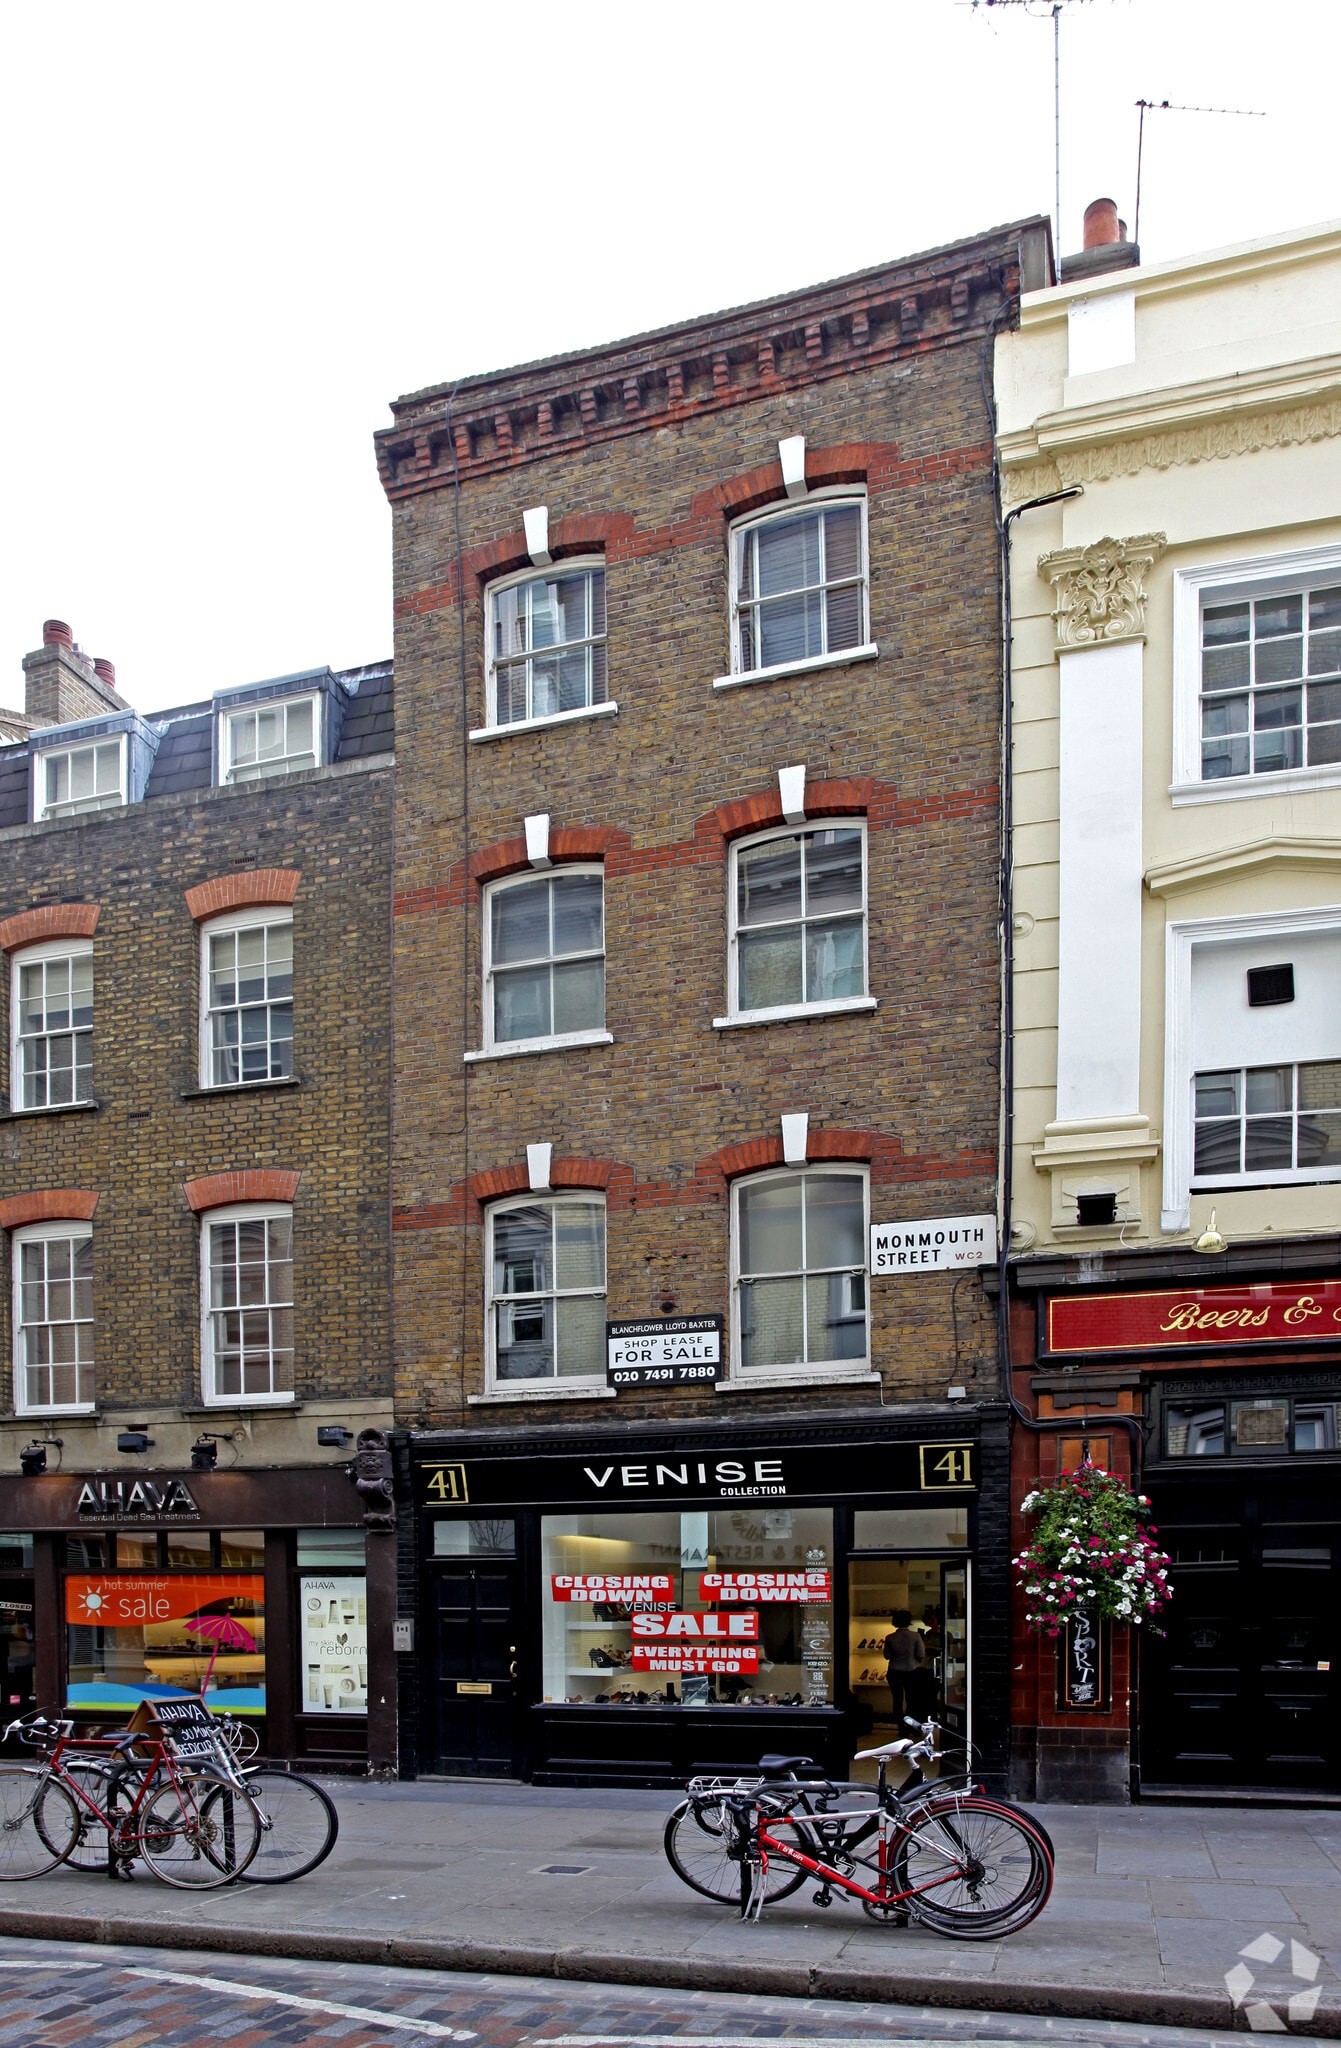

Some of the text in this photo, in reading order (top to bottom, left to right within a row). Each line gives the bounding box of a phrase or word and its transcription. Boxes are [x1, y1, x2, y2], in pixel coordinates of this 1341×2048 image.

[876, 1228, 984, 1249] MONMOUTH
[877, 1249, 983, 1266] STREET WC2
[1160, 1302, 1271, 1331] Beers
[1283, 1296, 1322, 1324] &
[612, 1320, 716, 1334] BLANCHFLOWER LLOYD BAXTER
[624, 1336, 703, 1348] SHOP LEASE
[615, 1346, 714, 1363] FOR SALE
[614, 1366, 716, 1382] 020 7491 7880
[933, 1450, 972, 1481] 41
[583, 1460, 784, 1487] VENISE
[427, 1470, 459, 1498] 41
[720, 1486, 786, 1496] COLLECTION
[76, 1480, 198, 1512] AHAVA
[79, 1512, 200, 1521] Essential Dead Sea Treatment
[104, 1580, 168, 1590] hot summer
[304, 1581, 336, 1590] AHAVA
[555, 1576, 669, 1588] CLOSING
[703, 1573, 826, 1587] CLOSING
[570, 1589, 653, 1602] DOWN
[720, 1588, 808, 1600] DOWN
[0, 1602, 31, 1610] CLOSED
[119, 1592, 170, 1618] sale
[623, 1601, 677, 1612] VENISE
[632, 1614, 755, 1636] SALE
[320, 1644, 367, 1655] reborn
[633, 1646, 757, 1659] EVERYTHING
[650, 1660, 740, 1672] MUST GO
[160, 1704, 206, 1720] AHAVA
[177, 1740, 215, 1756] PEDICUR
